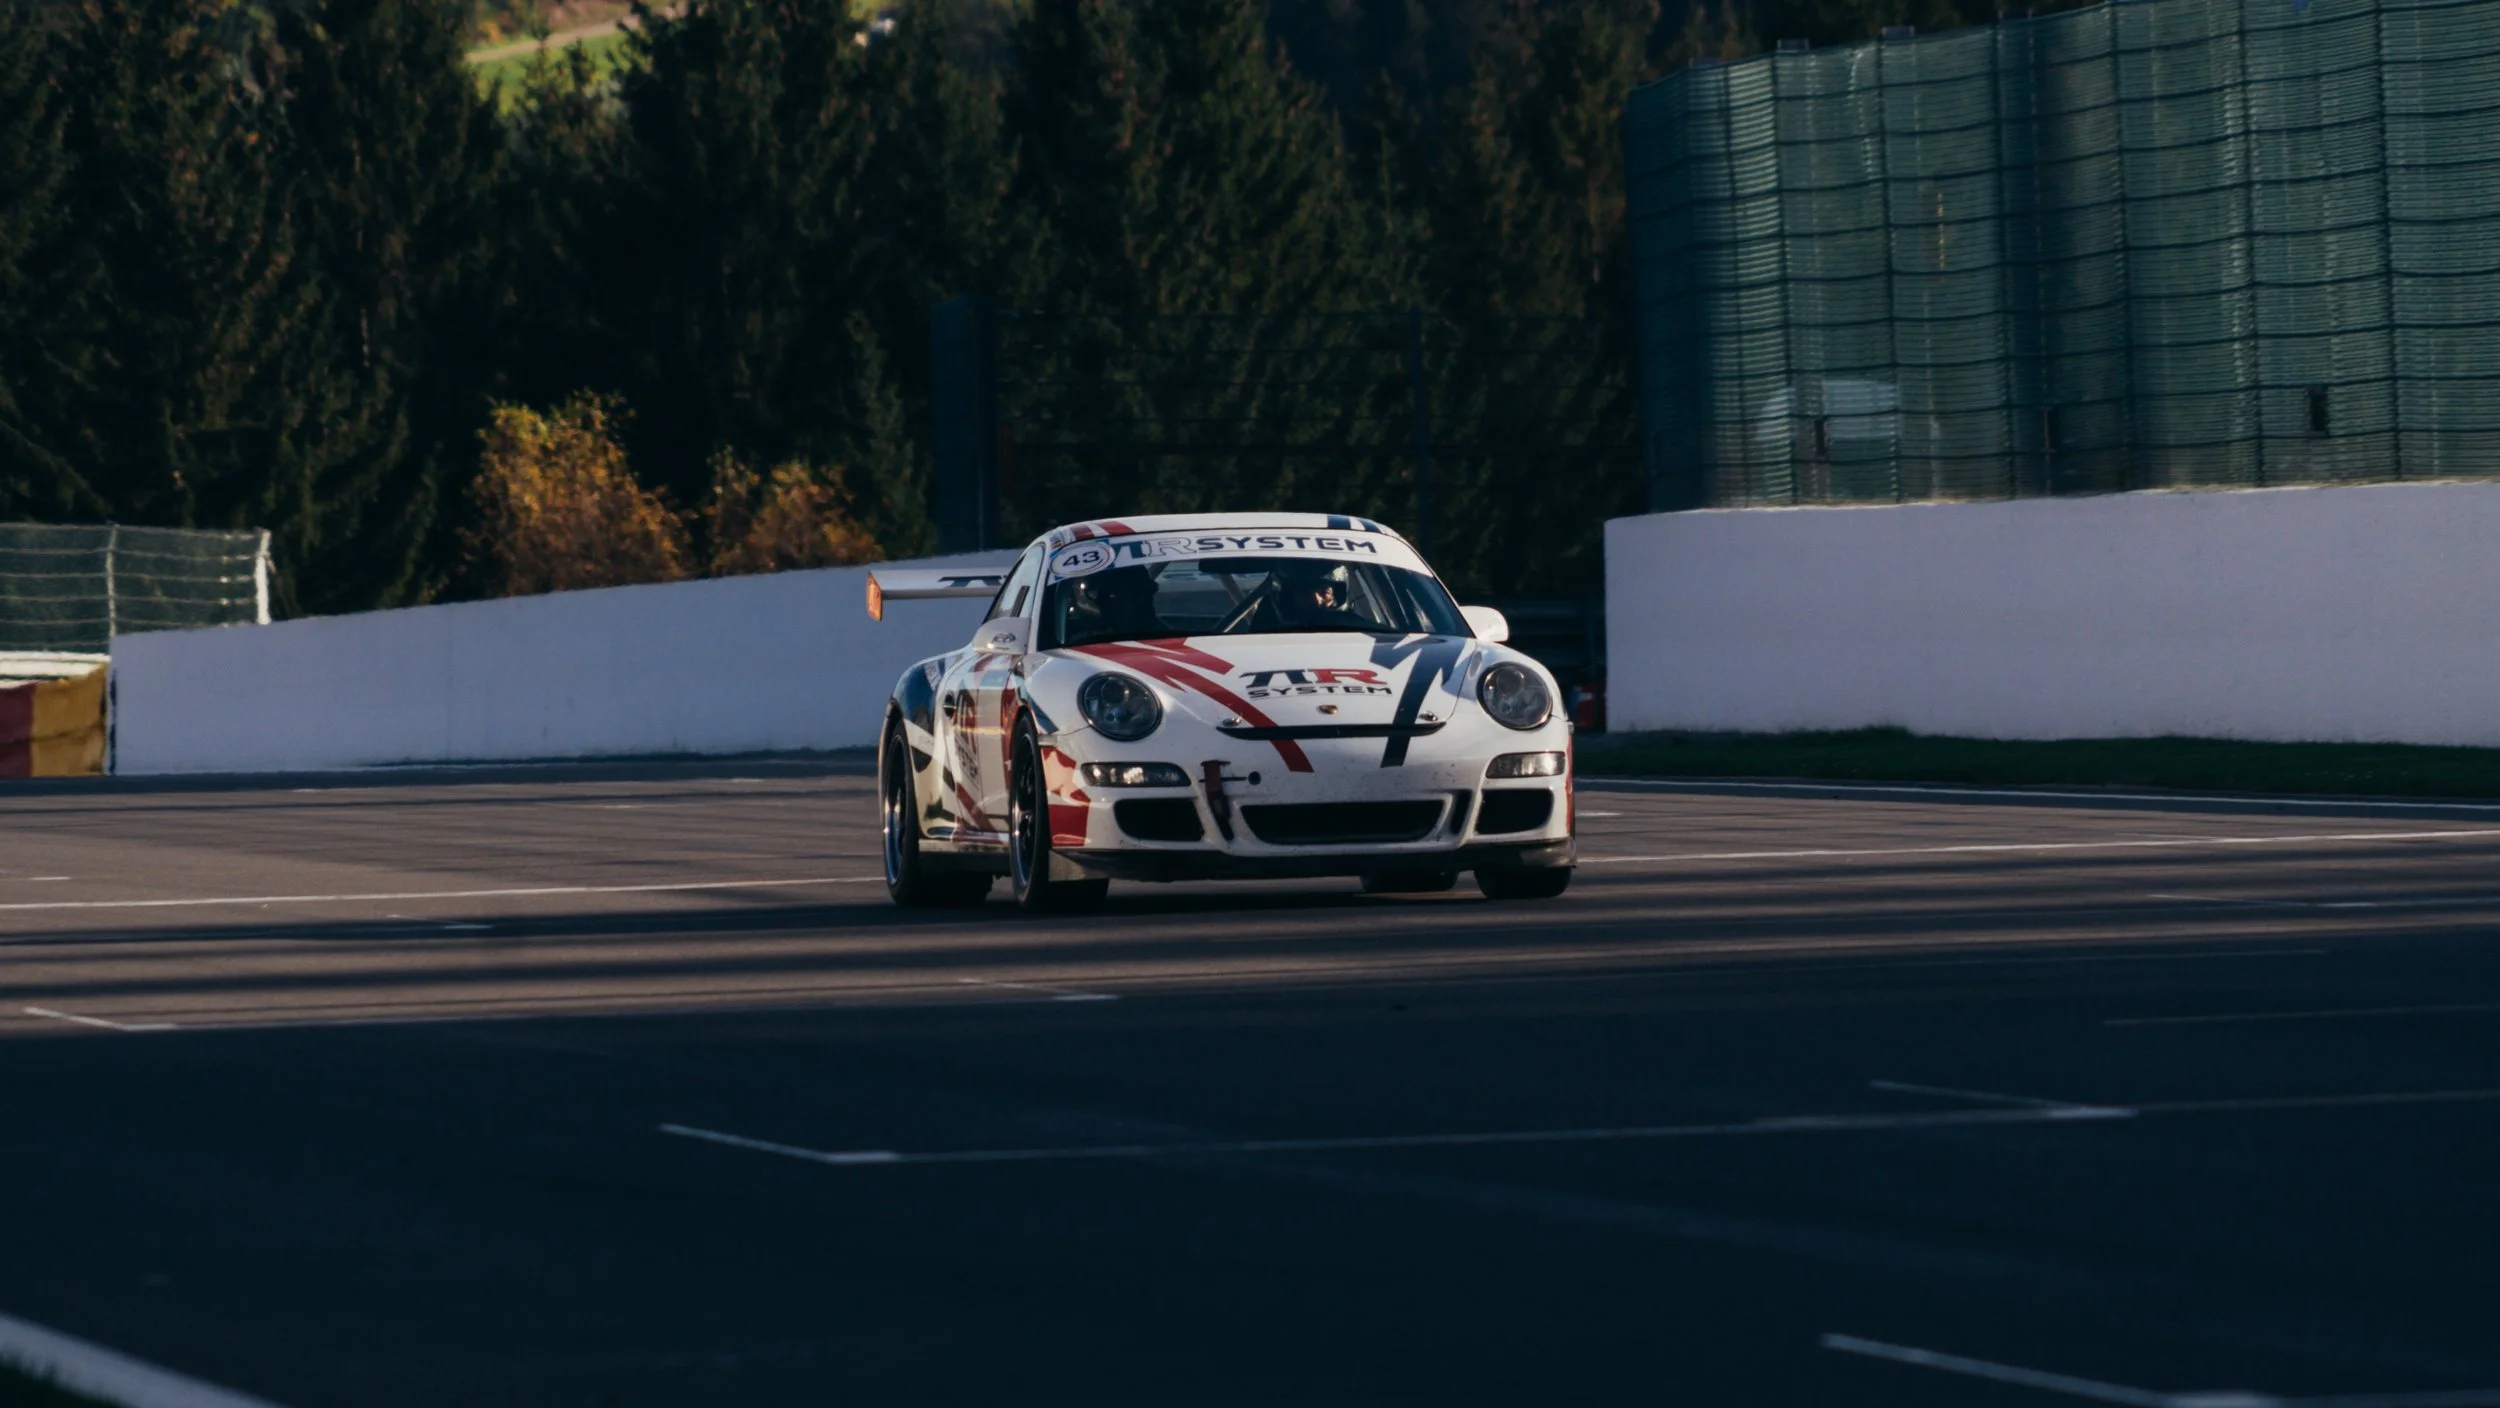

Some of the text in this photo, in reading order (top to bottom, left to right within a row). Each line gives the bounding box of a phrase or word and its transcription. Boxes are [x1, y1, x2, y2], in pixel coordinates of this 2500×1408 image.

[1196, 535, 1377, 554] SYSTEM
[1062, 551, 1102, 568] 43
[1247, 685, 1393, 699] SYSTEM
